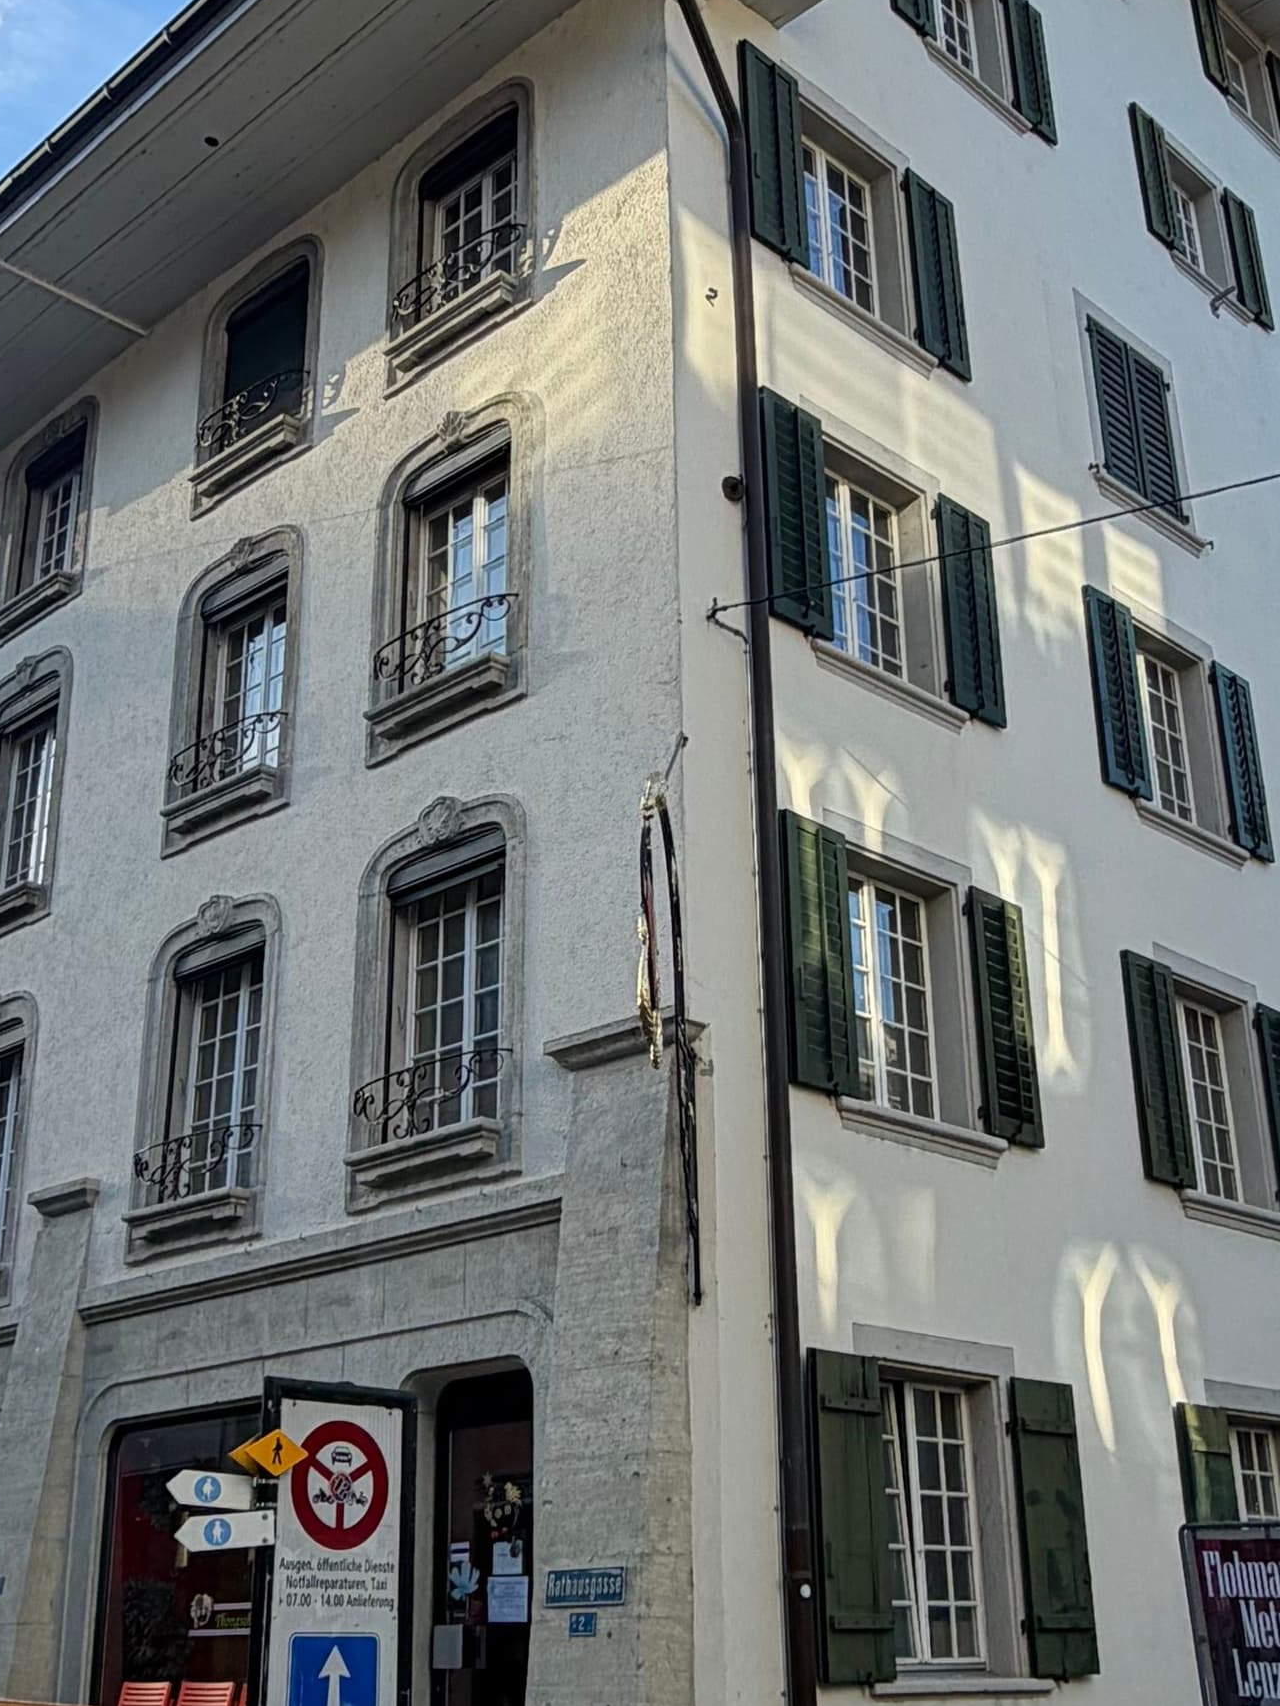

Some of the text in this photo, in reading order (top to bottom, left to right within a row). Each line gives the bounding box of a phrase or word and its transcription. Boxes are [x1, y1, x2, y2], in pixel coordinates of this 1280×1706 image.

[279, 1557, 395, 1574] Ausgen. öffentliche Dienste
[370, 1577, 388, 1590] Taxi
[547, 1573, 622, 1601] Rathausgasse
[286, 1593, 312, 1607] 07.00
[320, 1594, 344, 1607] 14.00
[345, 1594, 395, 1612] Anlieferung
